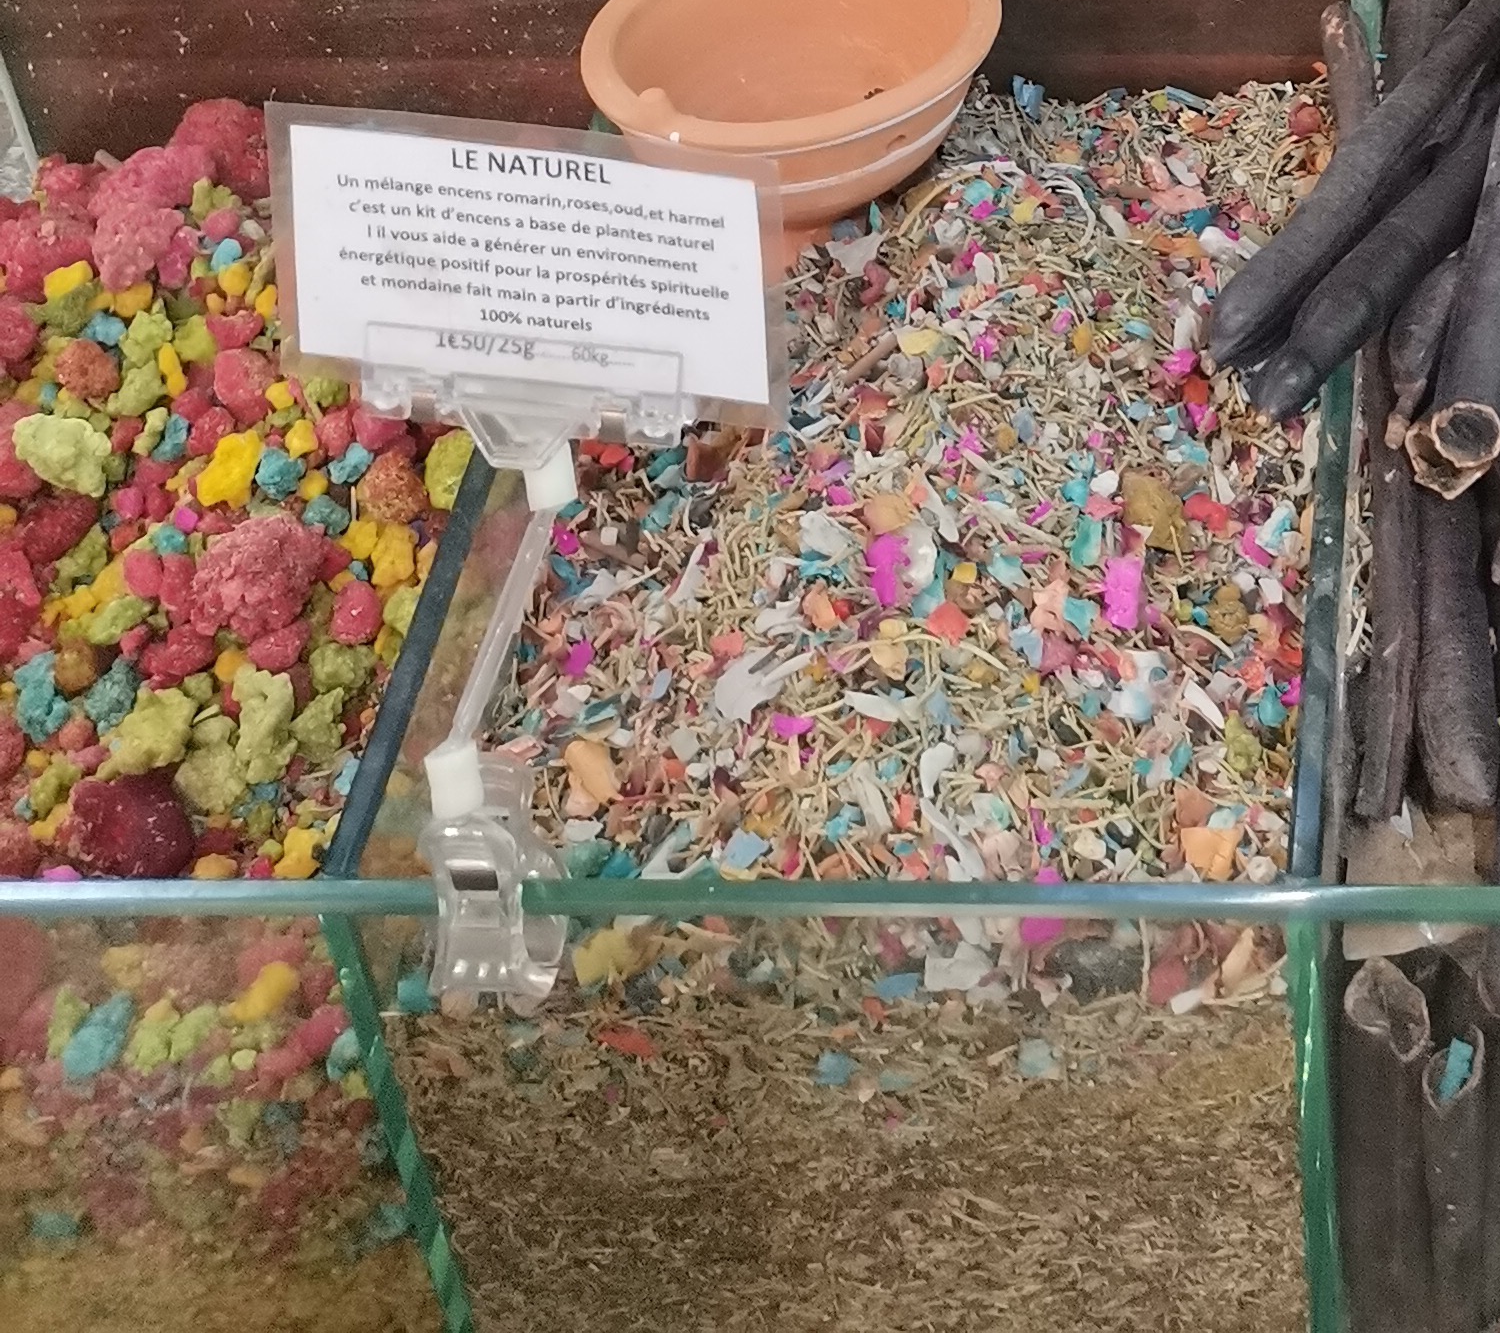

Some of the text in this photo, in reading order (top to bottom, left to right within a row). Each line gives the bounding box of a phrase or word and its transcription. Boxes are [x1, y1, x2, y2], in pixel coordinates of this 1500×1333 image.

[451, 148, 611, 185] LE NATUREL
[337, 174, 360, 188] Un
[364, 177, 434, 196] mélange
[437, 185, 493, 201] encens
[668, 209, 725, 229] harmel
[348, 199, 715, 252] c’est un kit d’encens a base de plantes naturel
[480, 308, 593, 332] 100% naturels
[436, 331, 539, 361] 1€50/25g
